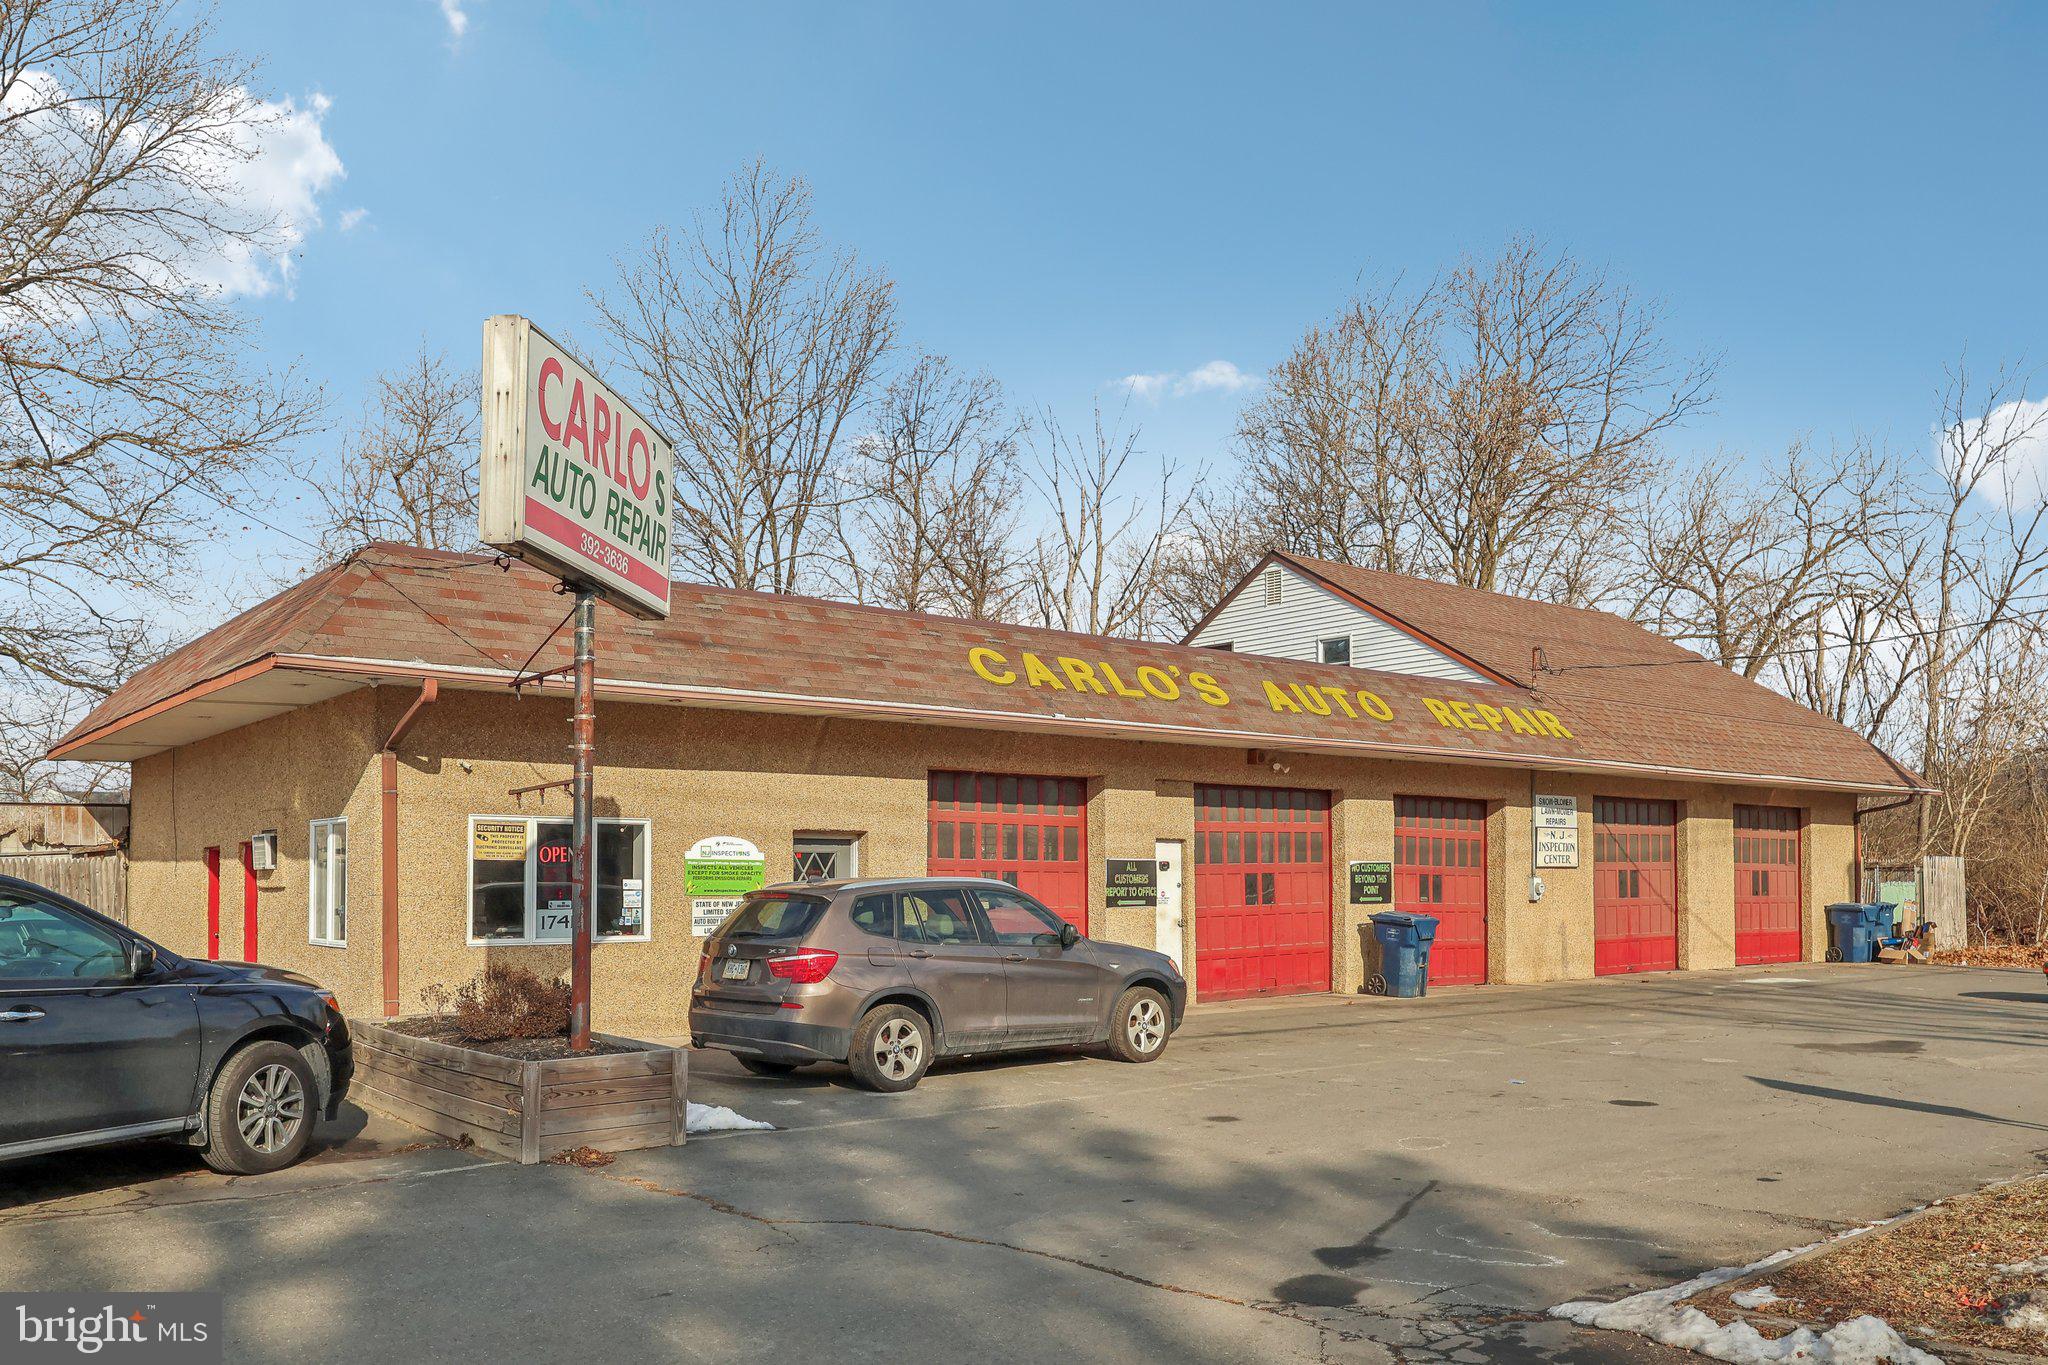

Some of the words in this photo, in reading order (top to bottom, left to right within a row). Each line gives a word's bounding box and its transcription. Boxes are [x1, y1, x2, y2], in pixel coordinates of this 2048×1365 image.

[538, 357, 665, 516] CARLO'S
[531, 445, 596, 520] AUTO
[604, 488, 666, 566] REPAIR
[580, 532, 629, 575] 392-3636
[969, 646, 1229, 707] CARLO'S
[1262, 680, 1394, 722] AUTO
[1422, 698, 1574, 740] REPAIR
[477, 824, 503, 832] SECURITY
[504, 825, 524, 833] NOTICE
[1538, 841, 1576, 853] INSPECTION
[1543, 854, 1571, 864] CENTER
[1126, 862, 1137, 871] ALL
[1351, 864, 1360, 872] NO
[1360, 864, 1390, 872] CUSTOMERS
[1115, 874, 1149, 884] CUSTOMERS
[1354, 874, 1376, 883] BEYOND
[1376, 874, 1388, 883] THIS
[1105, 886, 1128, 897] REPORT
[1128, 886, 1137, 897] TO
[1137, 886, 1157, 897] OFFICE
[1363, 886, 1379, 894] POINT
[541, 914, 573, 930] 174
